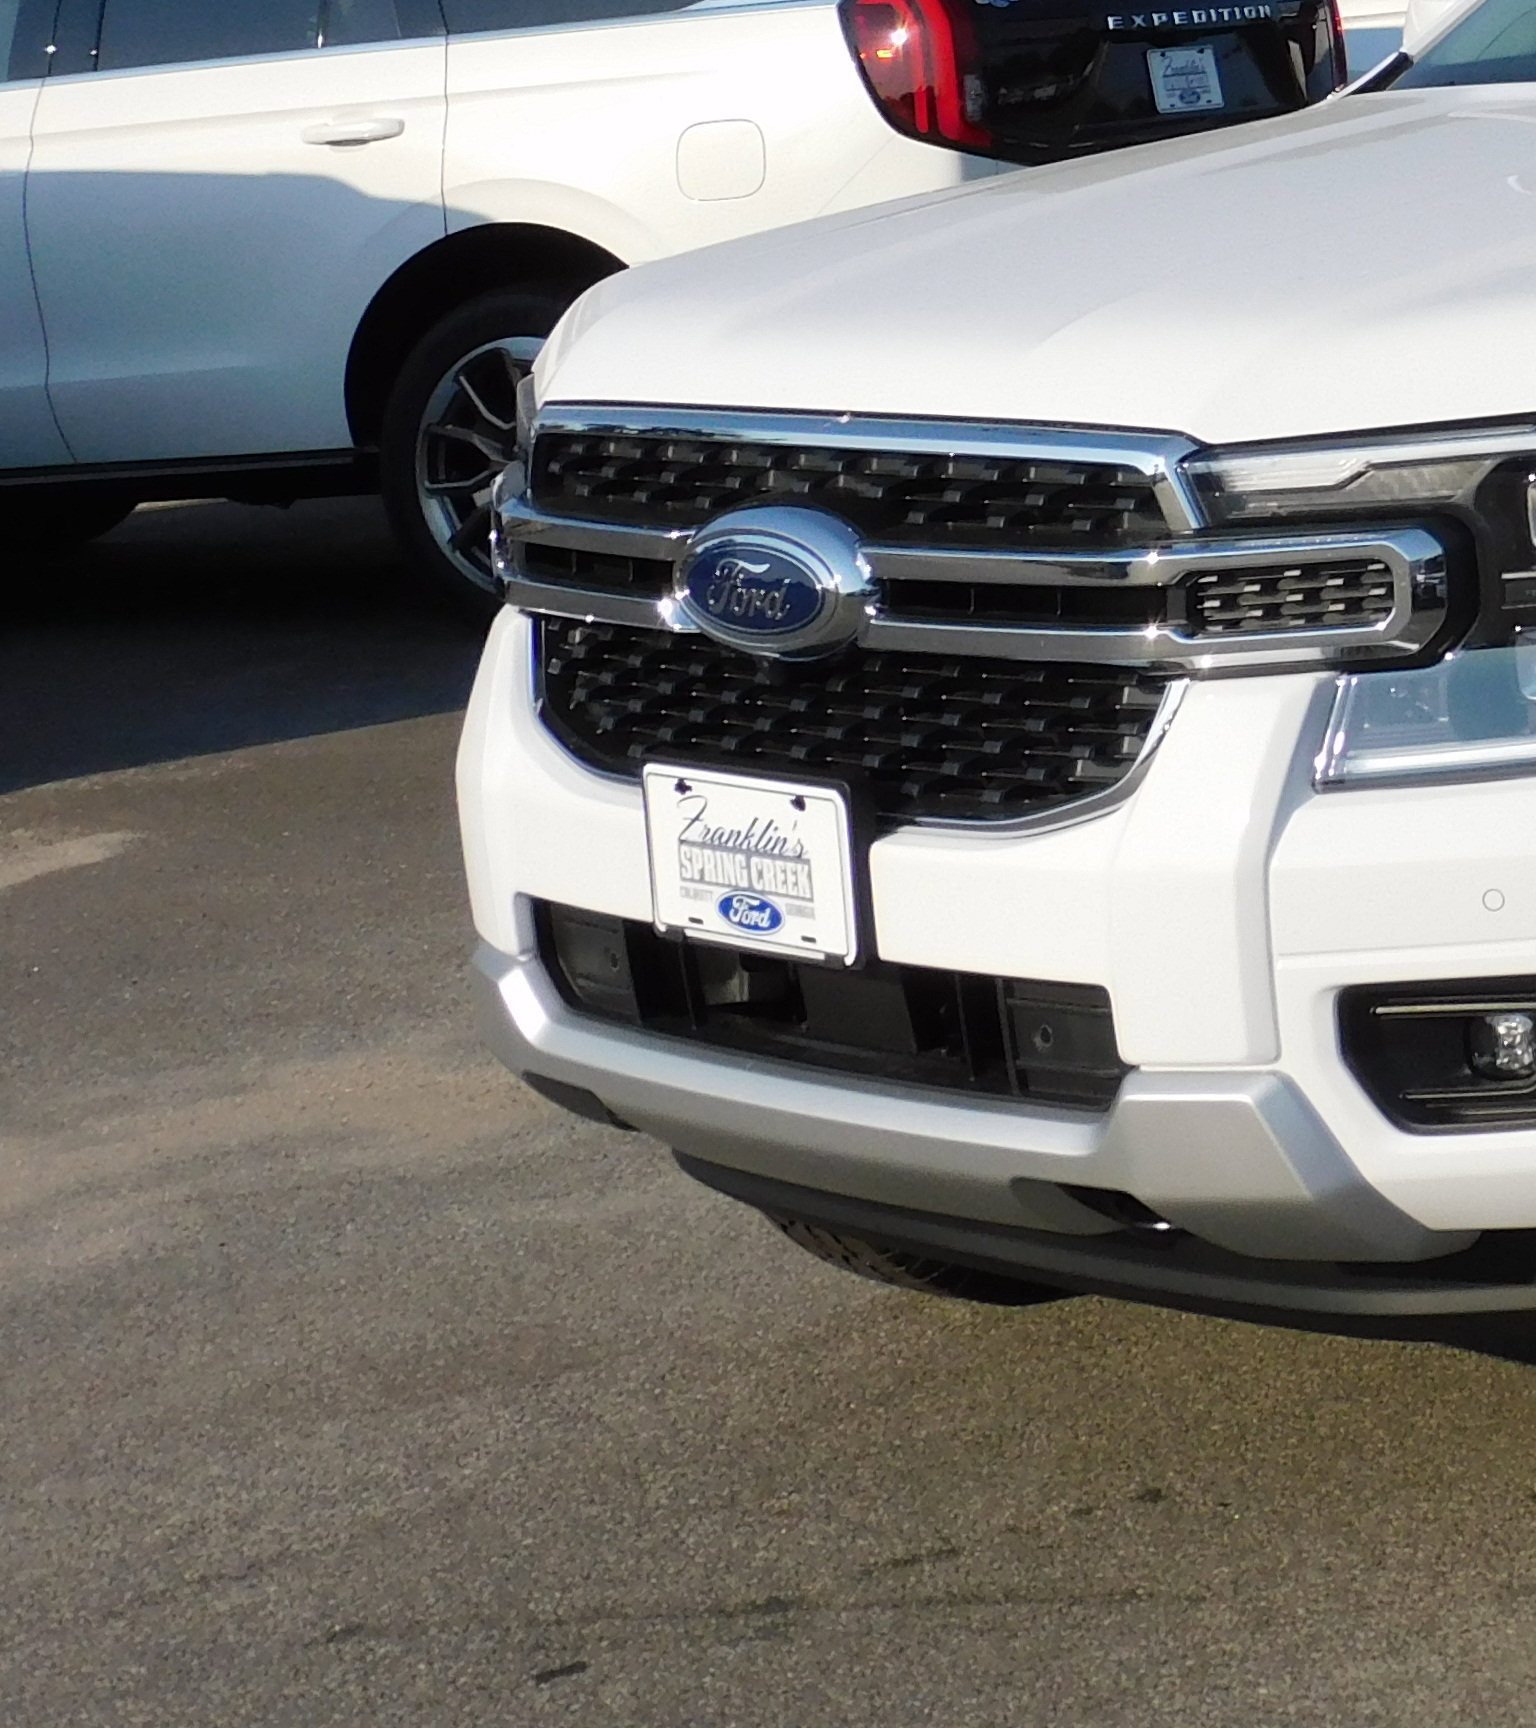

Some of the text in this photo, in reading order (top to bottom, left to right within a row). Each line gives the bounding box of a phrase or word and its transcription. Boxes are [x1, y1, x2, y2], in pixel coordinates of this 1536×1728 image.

[1107, 5, 1271, 30] EXPEDITION
[706, 558, 791, 620] Ford
[677, 795, 807, 859] Franklin's
[681, 844, 812, 900] SPRING CREEK
[729, 896, 771, 928] Ford
